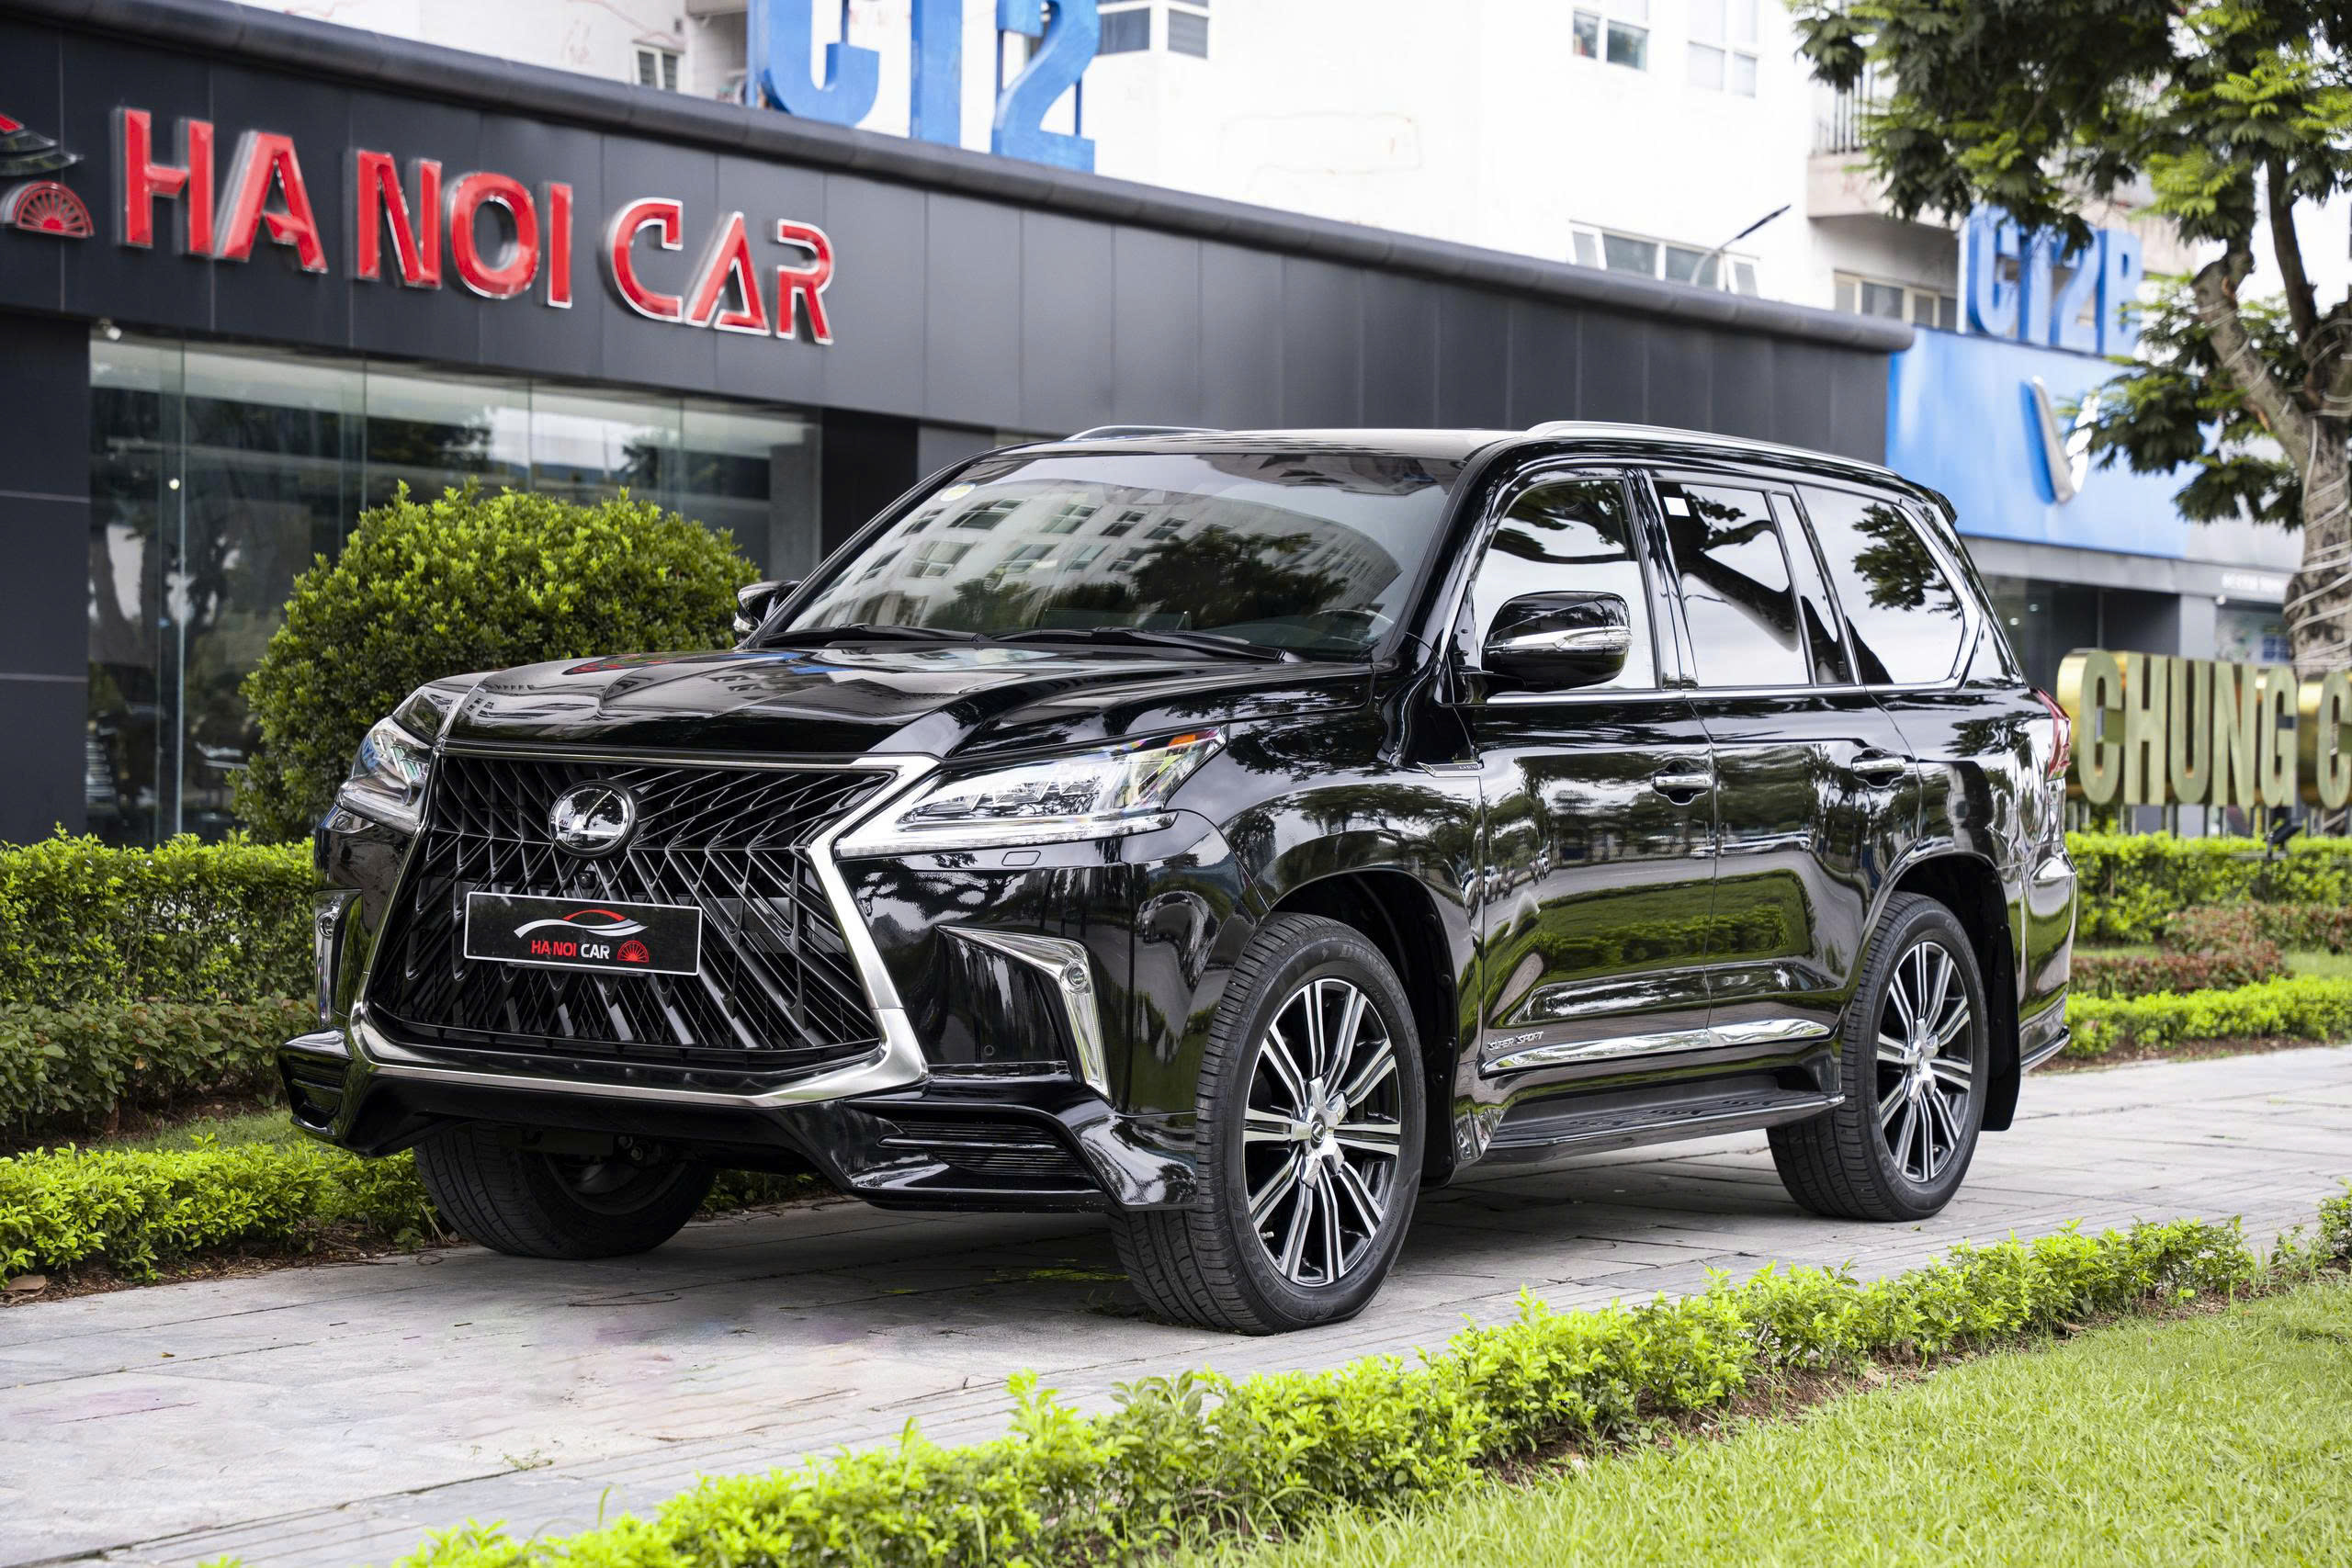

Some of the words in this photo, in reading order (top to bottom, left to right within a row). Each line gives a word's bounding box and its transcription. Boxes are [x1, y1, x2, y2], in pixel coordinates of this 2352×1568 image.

[608, 196, 835, 345] CAR
[2069, 649, 2299, 814] CHUNG
[580, 943, 610, 960] CAR
[1515, 1031, 1544, 1044] SPORT
